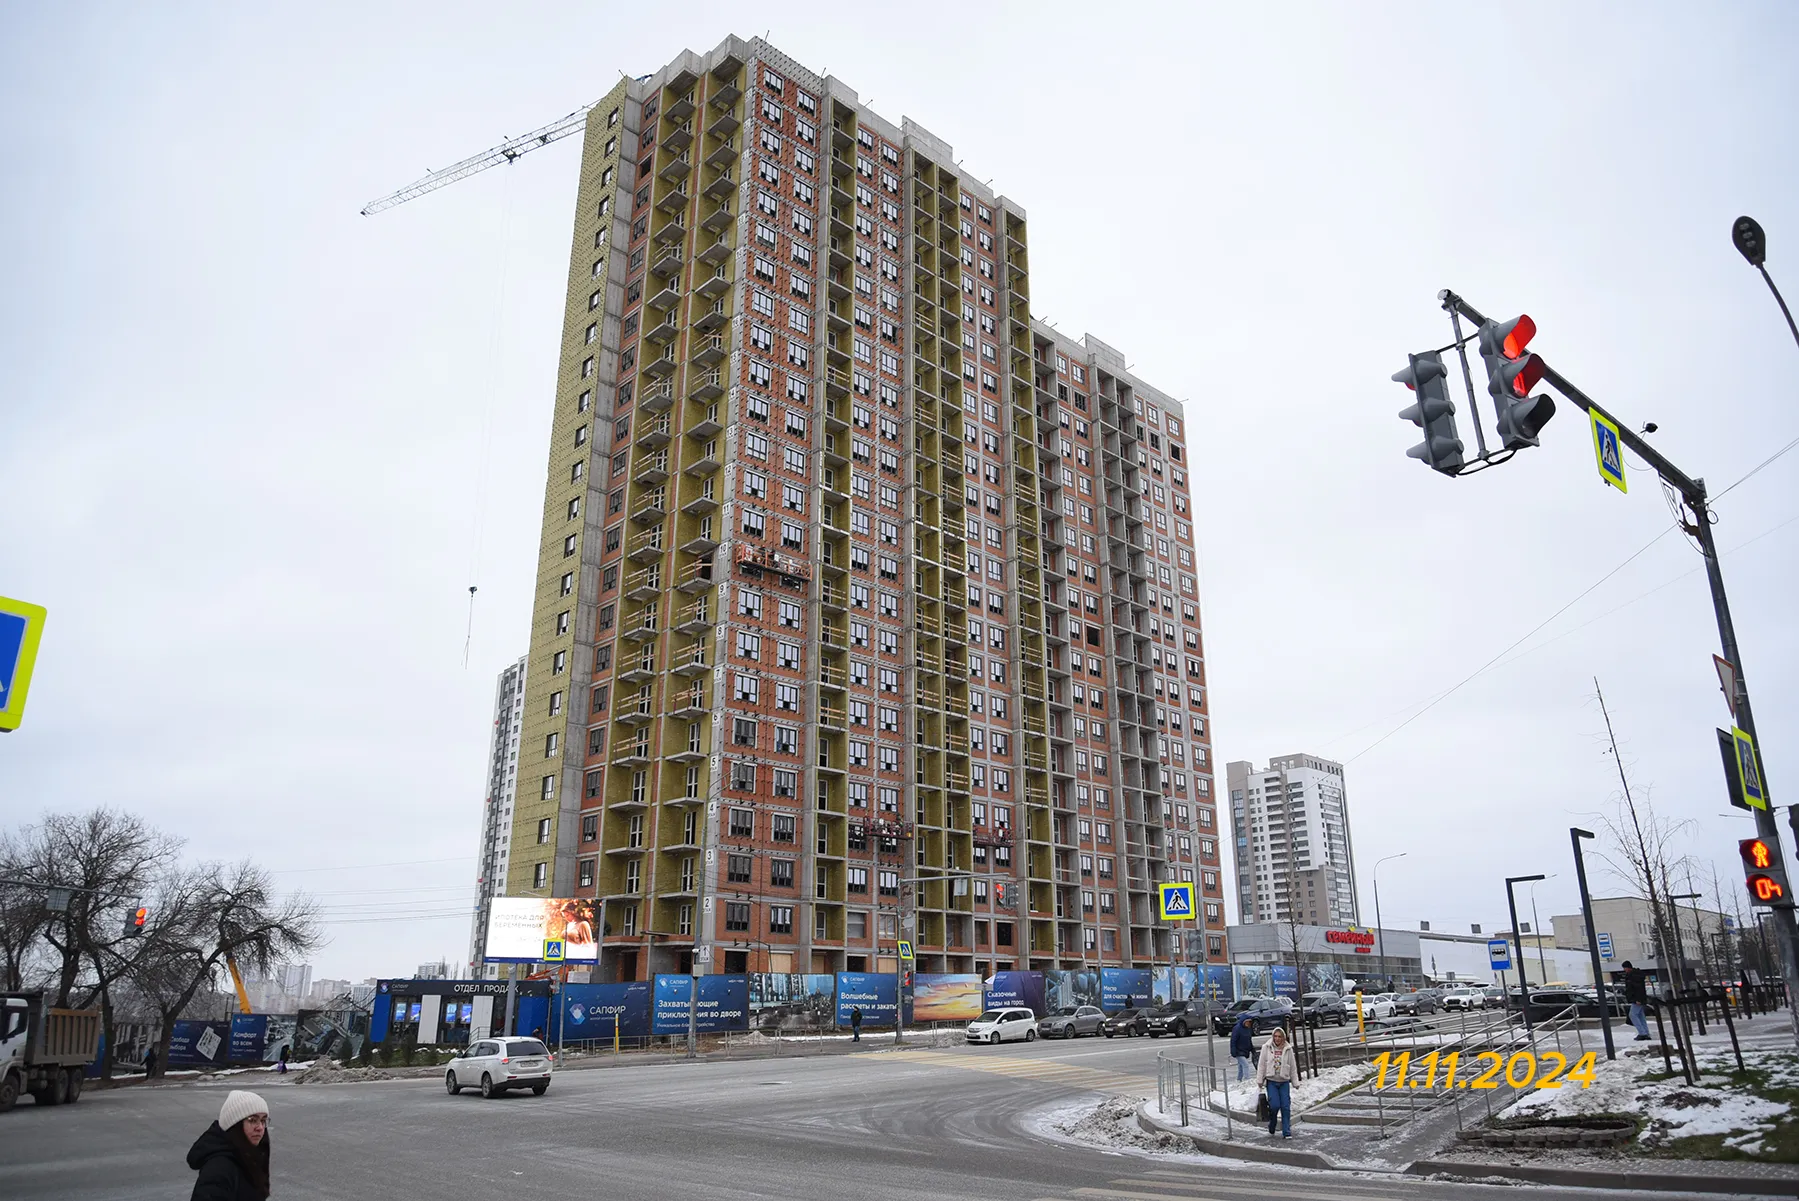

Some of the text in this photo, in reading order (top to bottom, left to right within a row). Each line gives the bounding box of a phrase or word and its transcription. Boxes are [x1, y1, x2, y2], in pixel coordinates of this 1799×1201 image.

[719, 584, 725, 594] 9
[715, 669, 721, 679] 7
[711, 758, 717, 768] 5
[709, 804, 715, 812] 4
[707, 850, 713, 860] 3
[705, 898, 711, 908] 2
[702, 947, 707, 956] 1
[453, 984, 480, 994] ОТДЕЛ
[840, 992, 879, 1000] Волшебные
[589, 1005, 627, 1015] САПФИР
[720, 1010, 742, 1018] дворе
